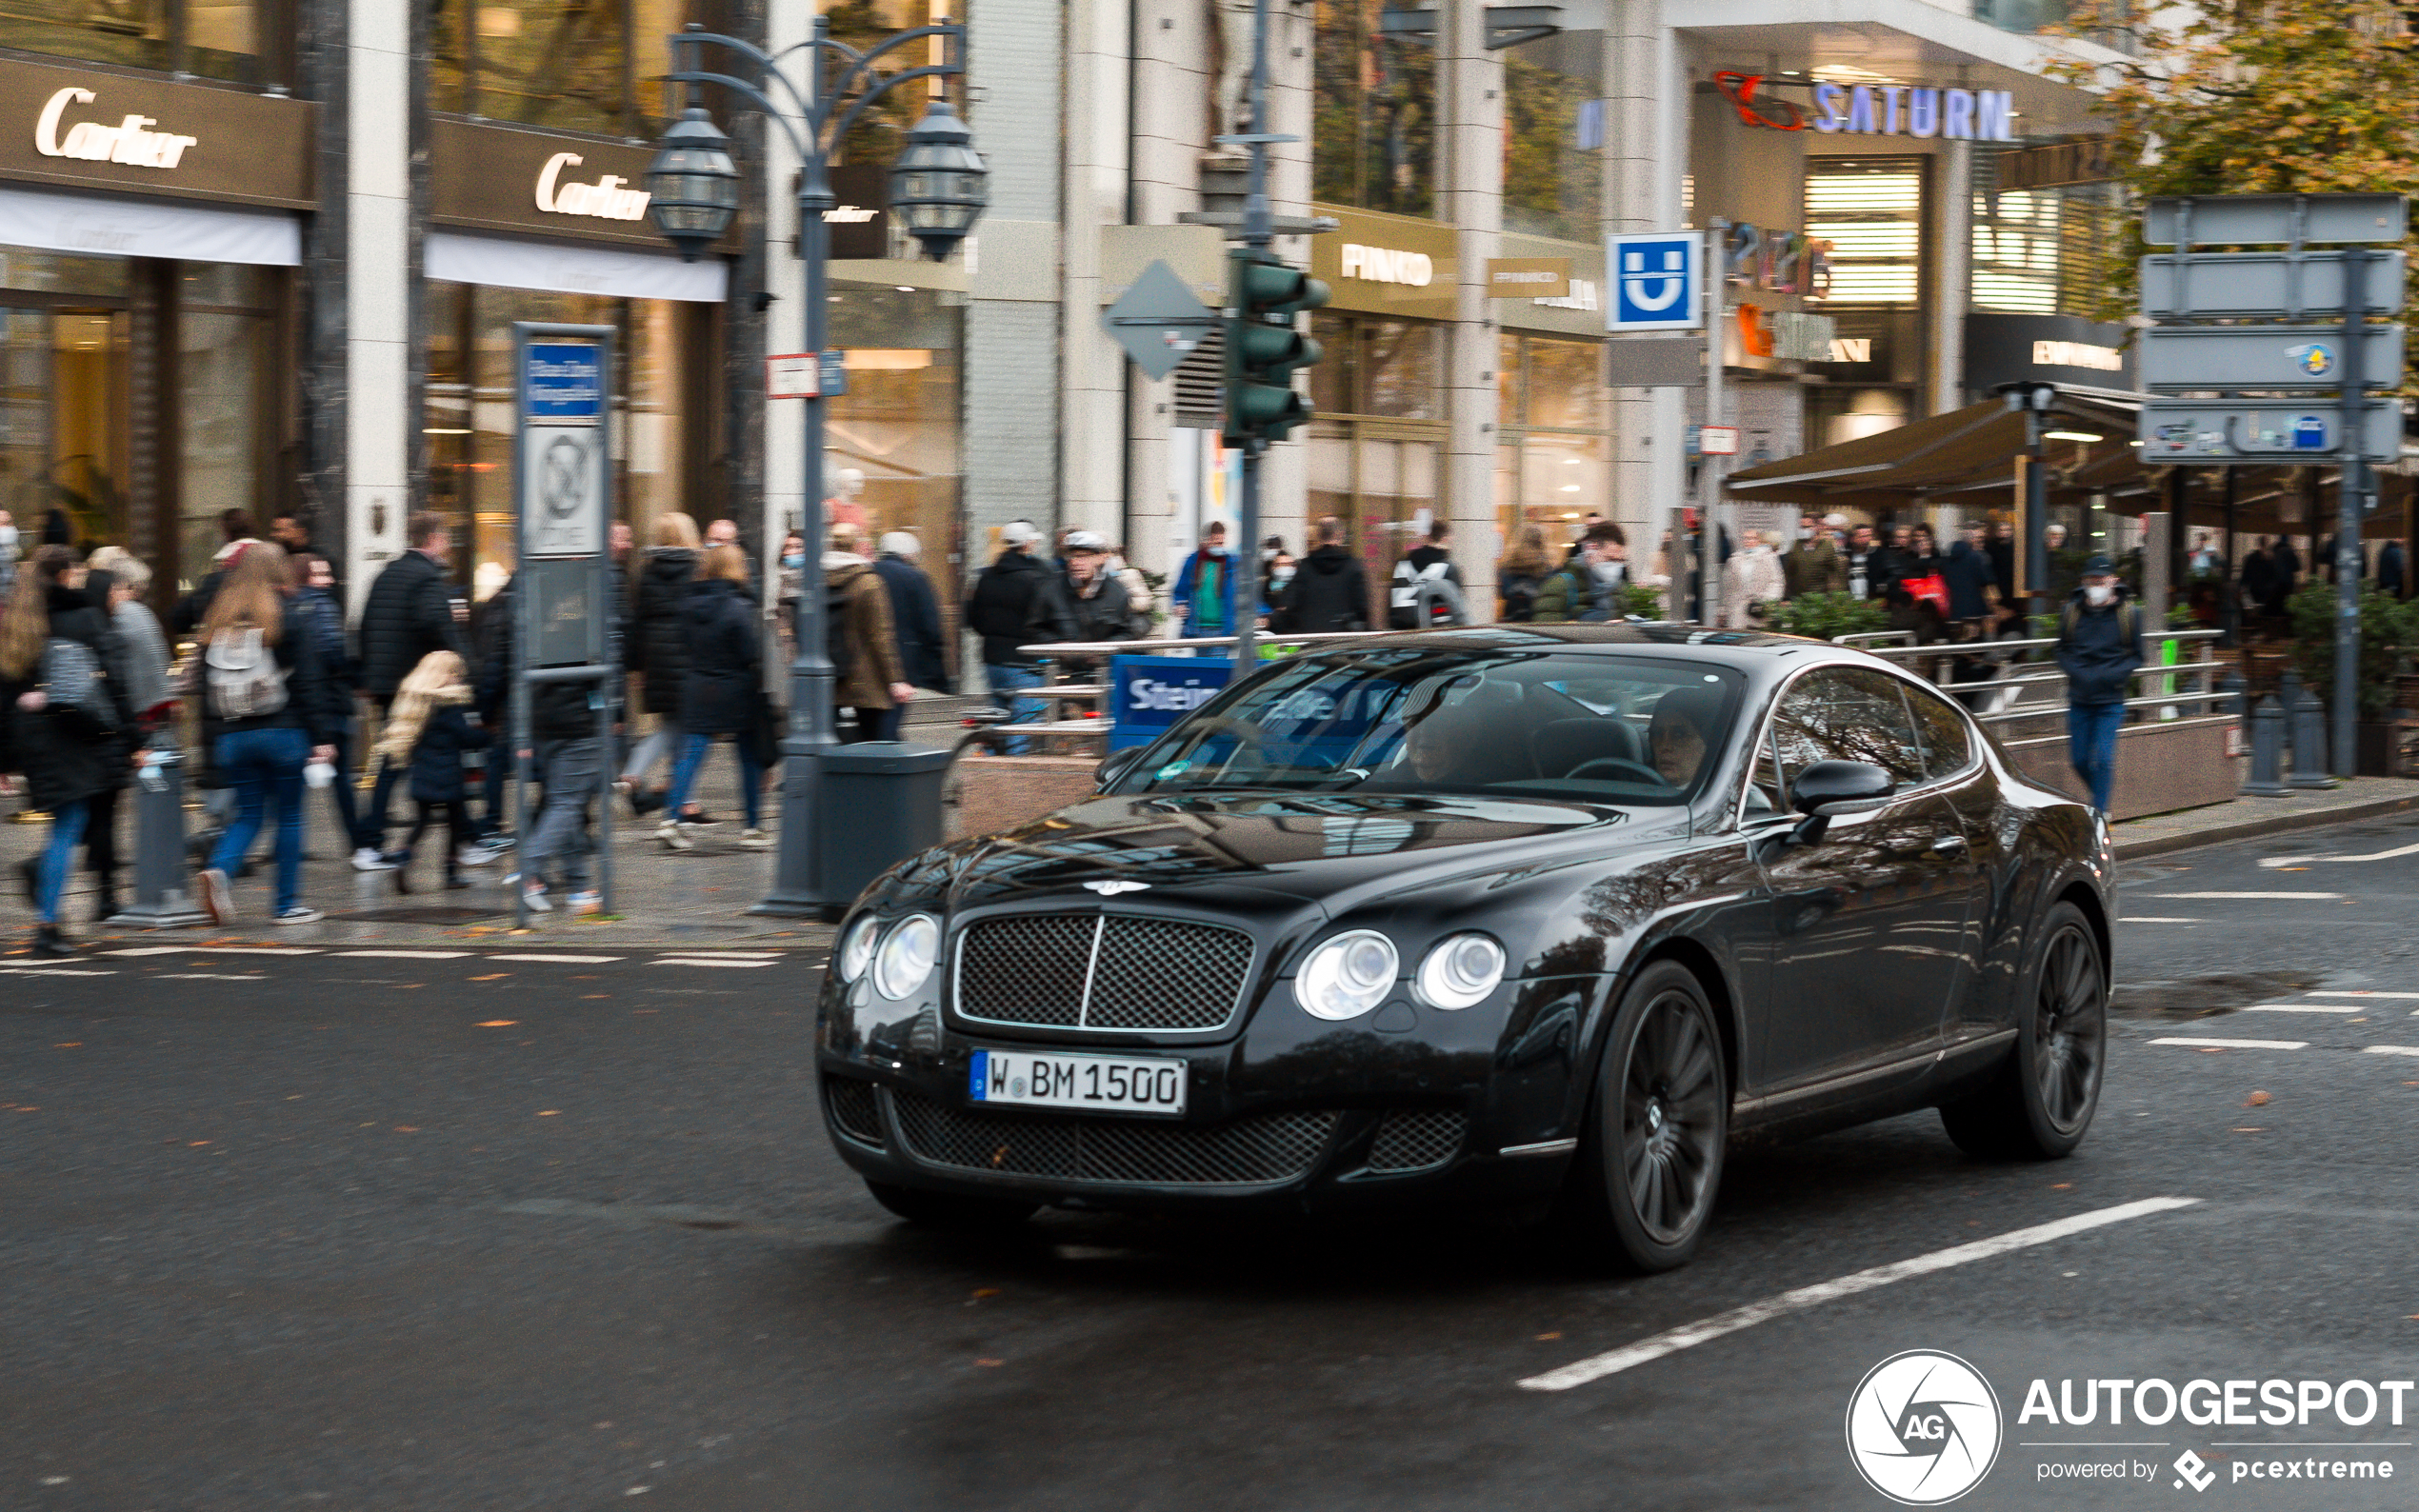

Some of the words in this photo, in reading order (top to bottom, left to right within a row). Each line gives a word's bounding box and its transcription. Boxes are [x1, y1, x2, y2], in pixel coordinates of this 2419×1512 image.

[35, 87, 197, 169] Cartier
[1811, 82, 2014, 141] SATURN
[990, 1058, 1009, 1095] W
